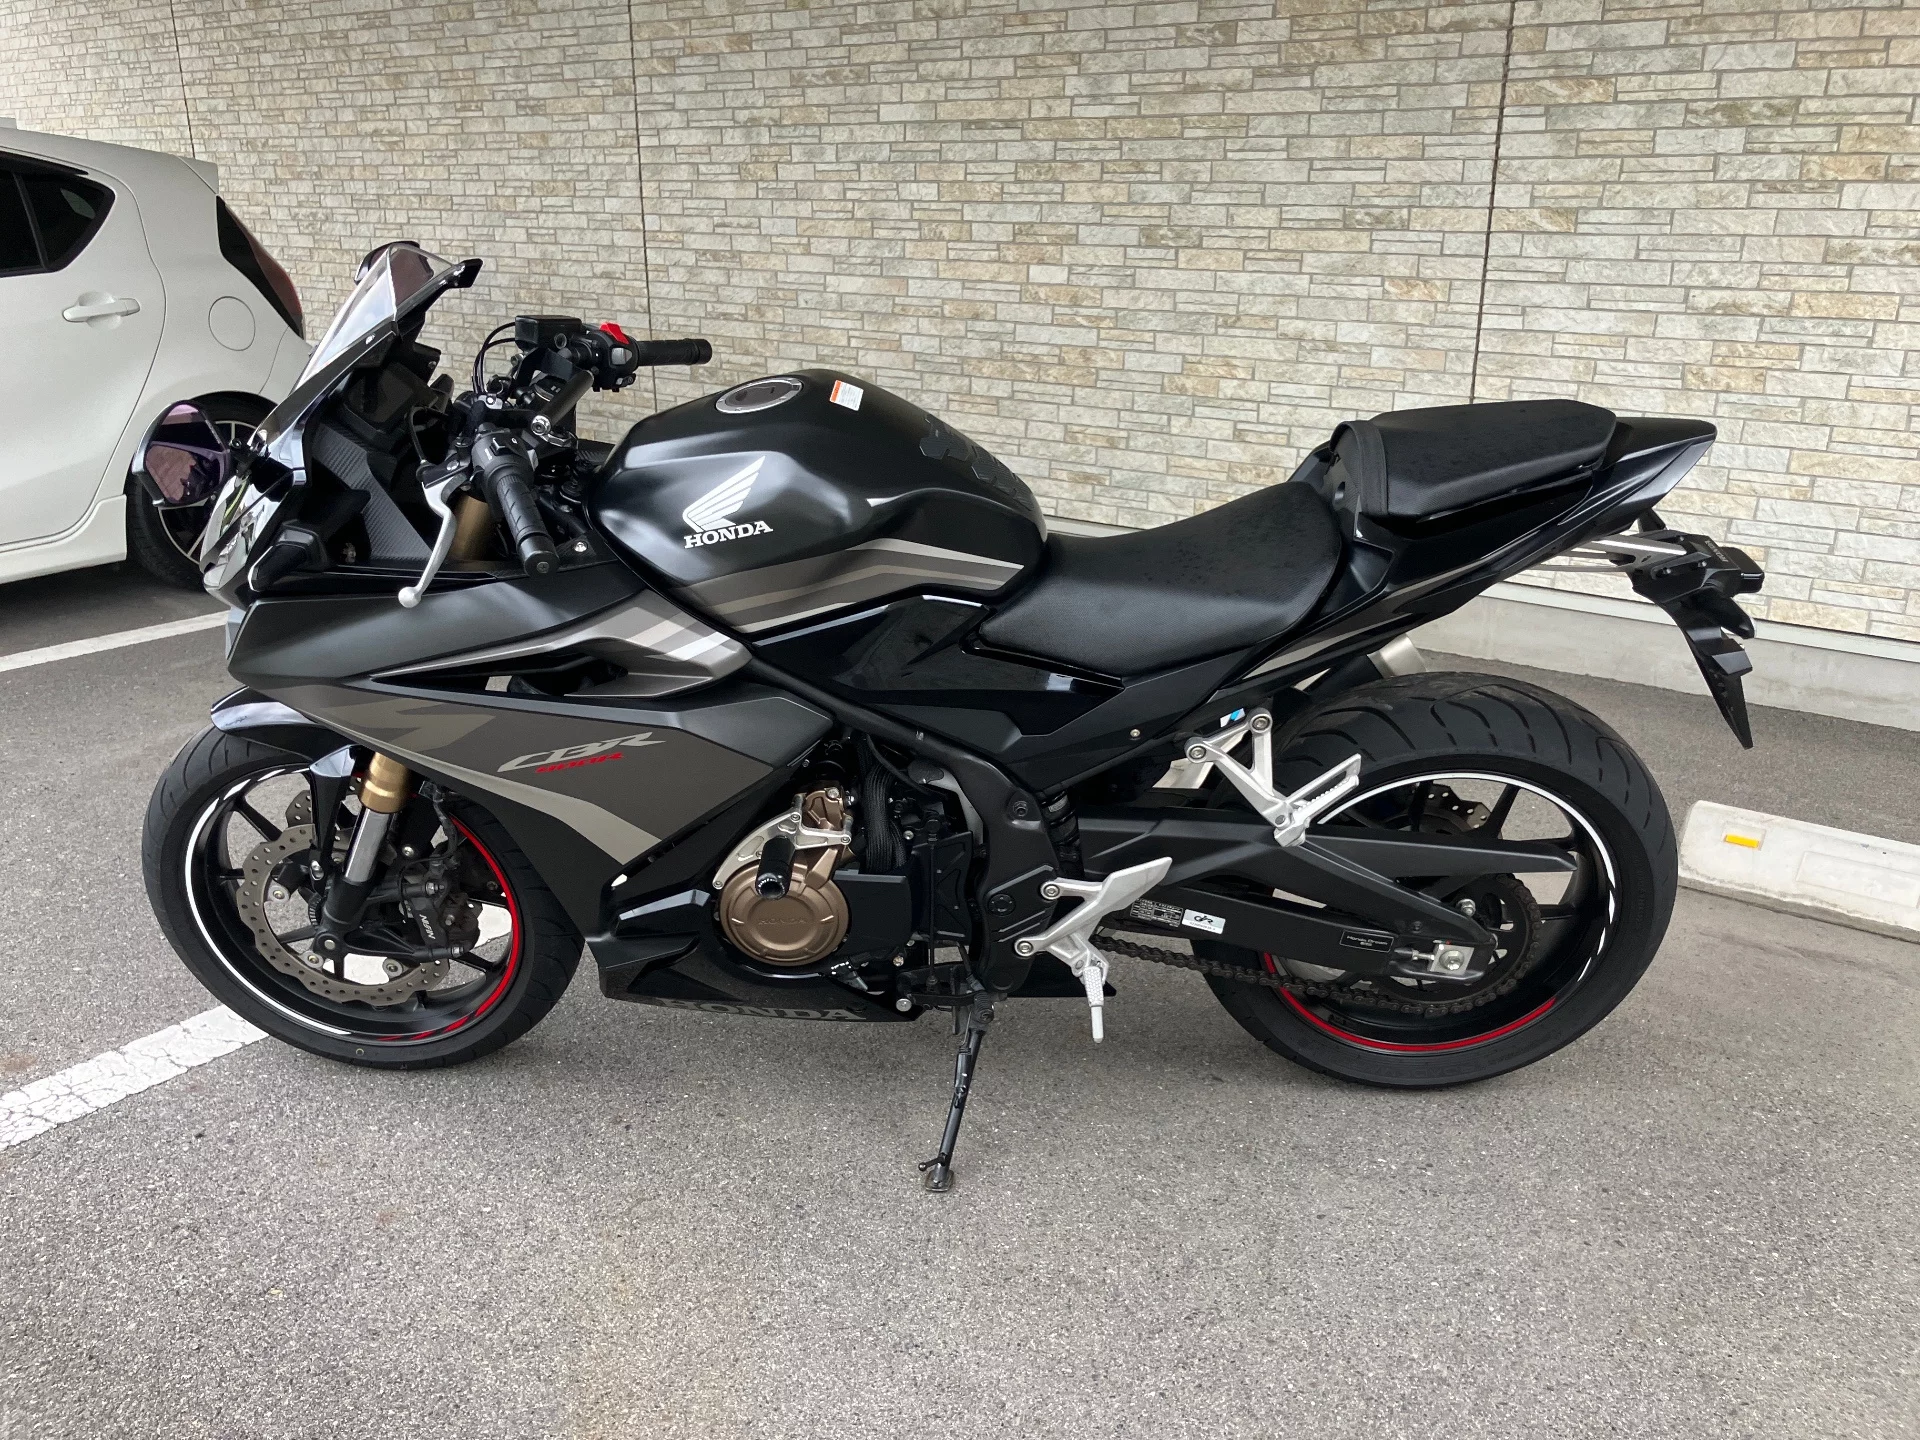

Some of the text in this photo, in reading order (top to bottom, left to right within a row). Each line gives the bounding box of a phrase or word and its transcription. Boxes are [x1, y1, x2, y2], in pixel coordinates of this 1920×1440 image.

[684, 520, 774, 549] HONDA
[497, 731, 667, 773] CBR
[656, 997, 867, 1020] HONDA
